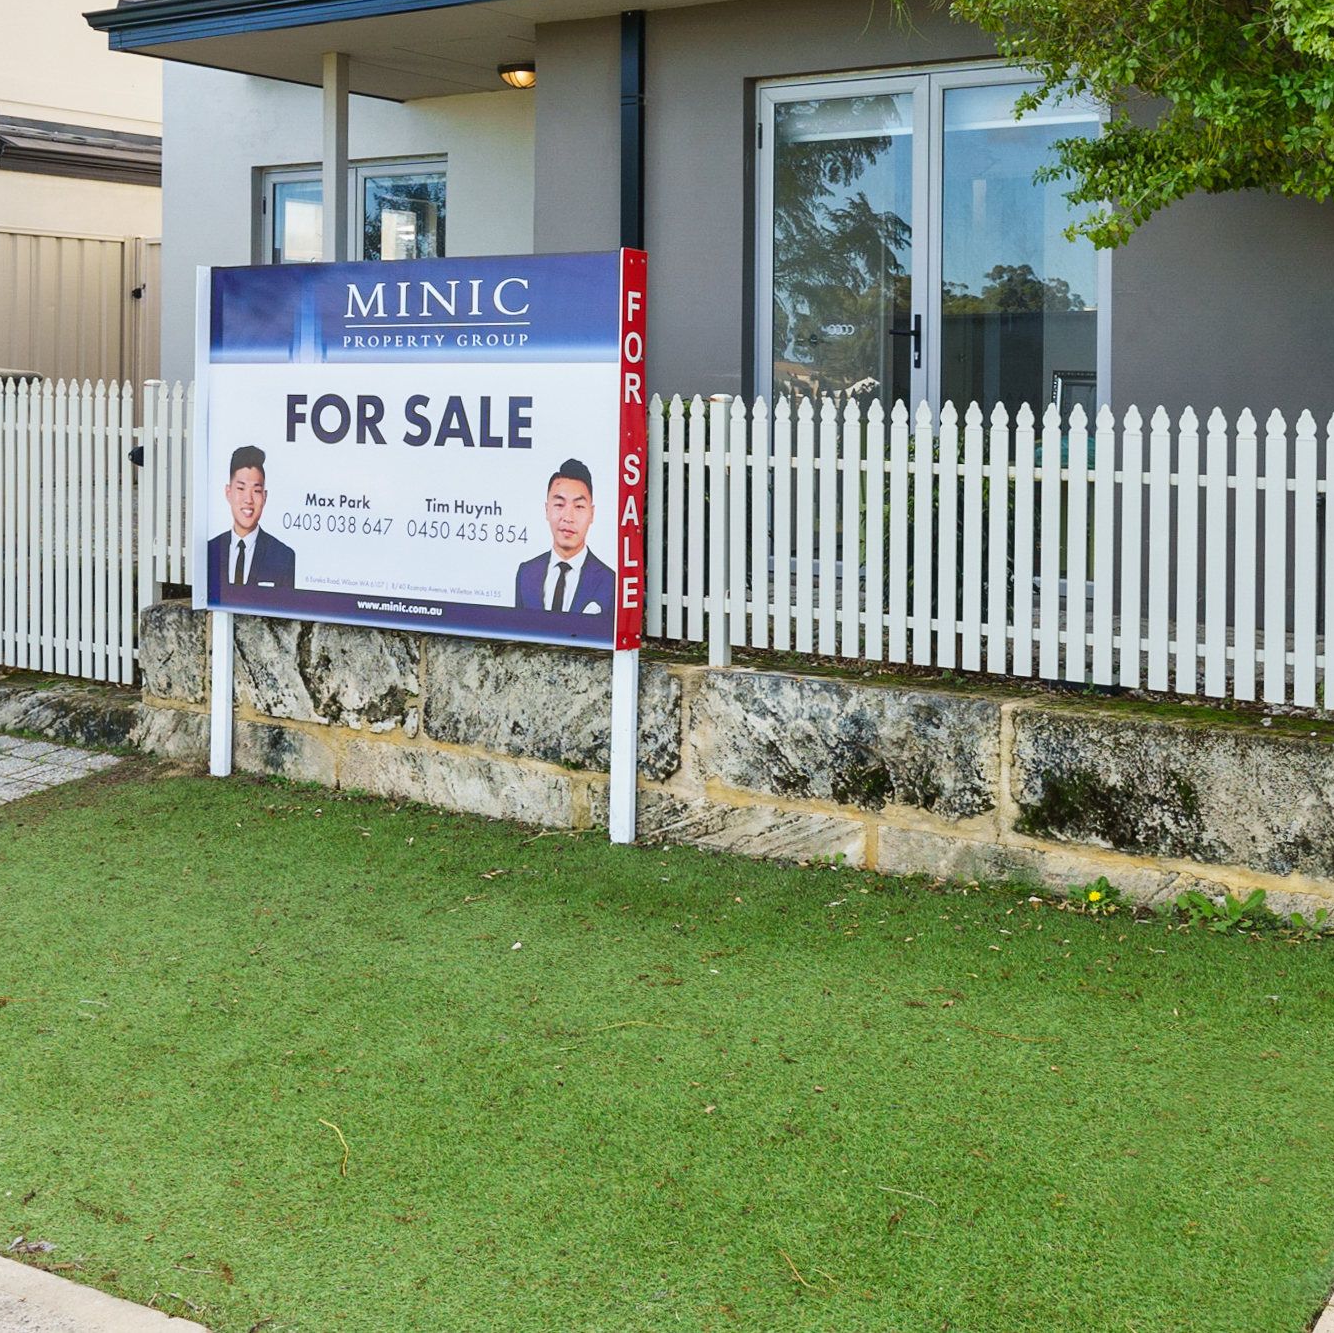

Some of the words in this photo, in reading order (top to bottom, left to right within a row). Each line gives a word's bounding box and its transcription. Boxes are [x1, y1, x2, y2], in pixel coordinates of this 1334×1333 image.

[344, 277, 529, 318] MINIC
[343, 334, 445, 348] PROPERTY
[456, 333, 529, 347] GROUP
[623, 290, 644, 405] FOR
[286, 393, 387, 445] FOR
[403, 394, 533, 449] SALE
[305, 493, 335, 508] Max
[339, 494, 371, 510] Park
[425, 498, 450, 514] Tim
[454, 500, 503, 520] Huynh
[282, 512, 322, 532] 0403
[326, 515, 357, 534] 038
[362, 517, 393, 536] 647
[407, 519, 451, 540] 0450
[455, 522, 489, 542] 435
[495, 524, 529, 545] 854
[620, 453, 641, 609] SALE
[357, 600, 442, 616] www.minic.com.au
